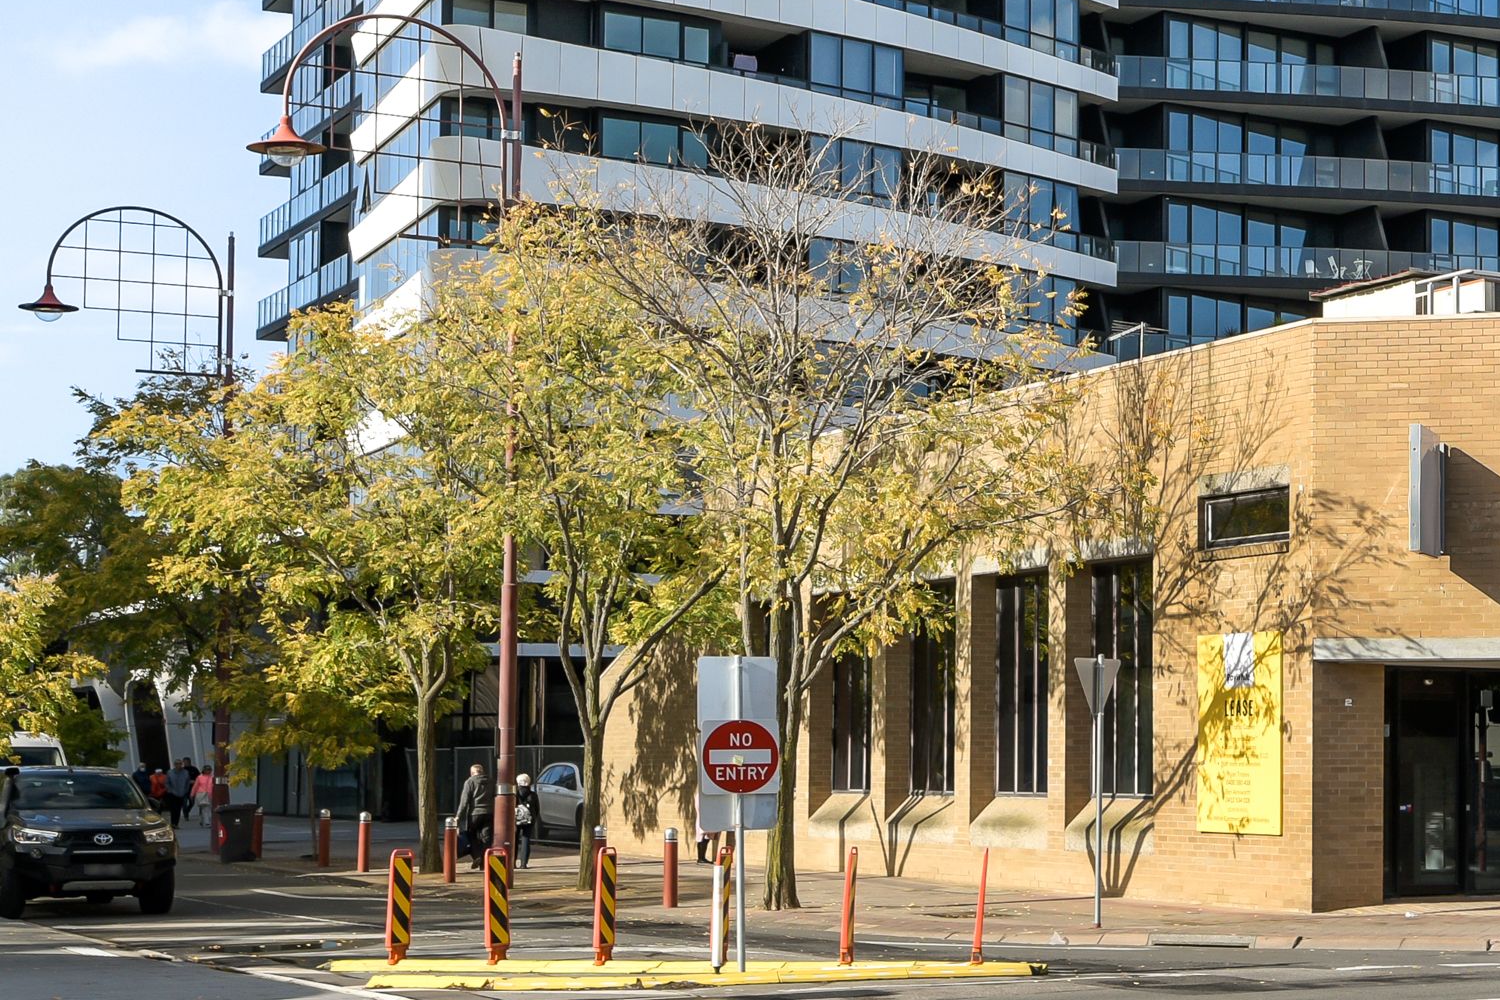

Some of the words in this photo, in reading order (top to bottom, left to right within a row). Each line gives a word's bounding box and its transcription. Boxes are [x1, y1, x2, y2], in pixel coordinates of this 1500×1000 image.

[1224, 700, 1254, 717] LEASE
[1344, 698, 1353, 707] 2
[729, 733, 753, 747] NO
[715, 766, 769, 781] ENTRY
